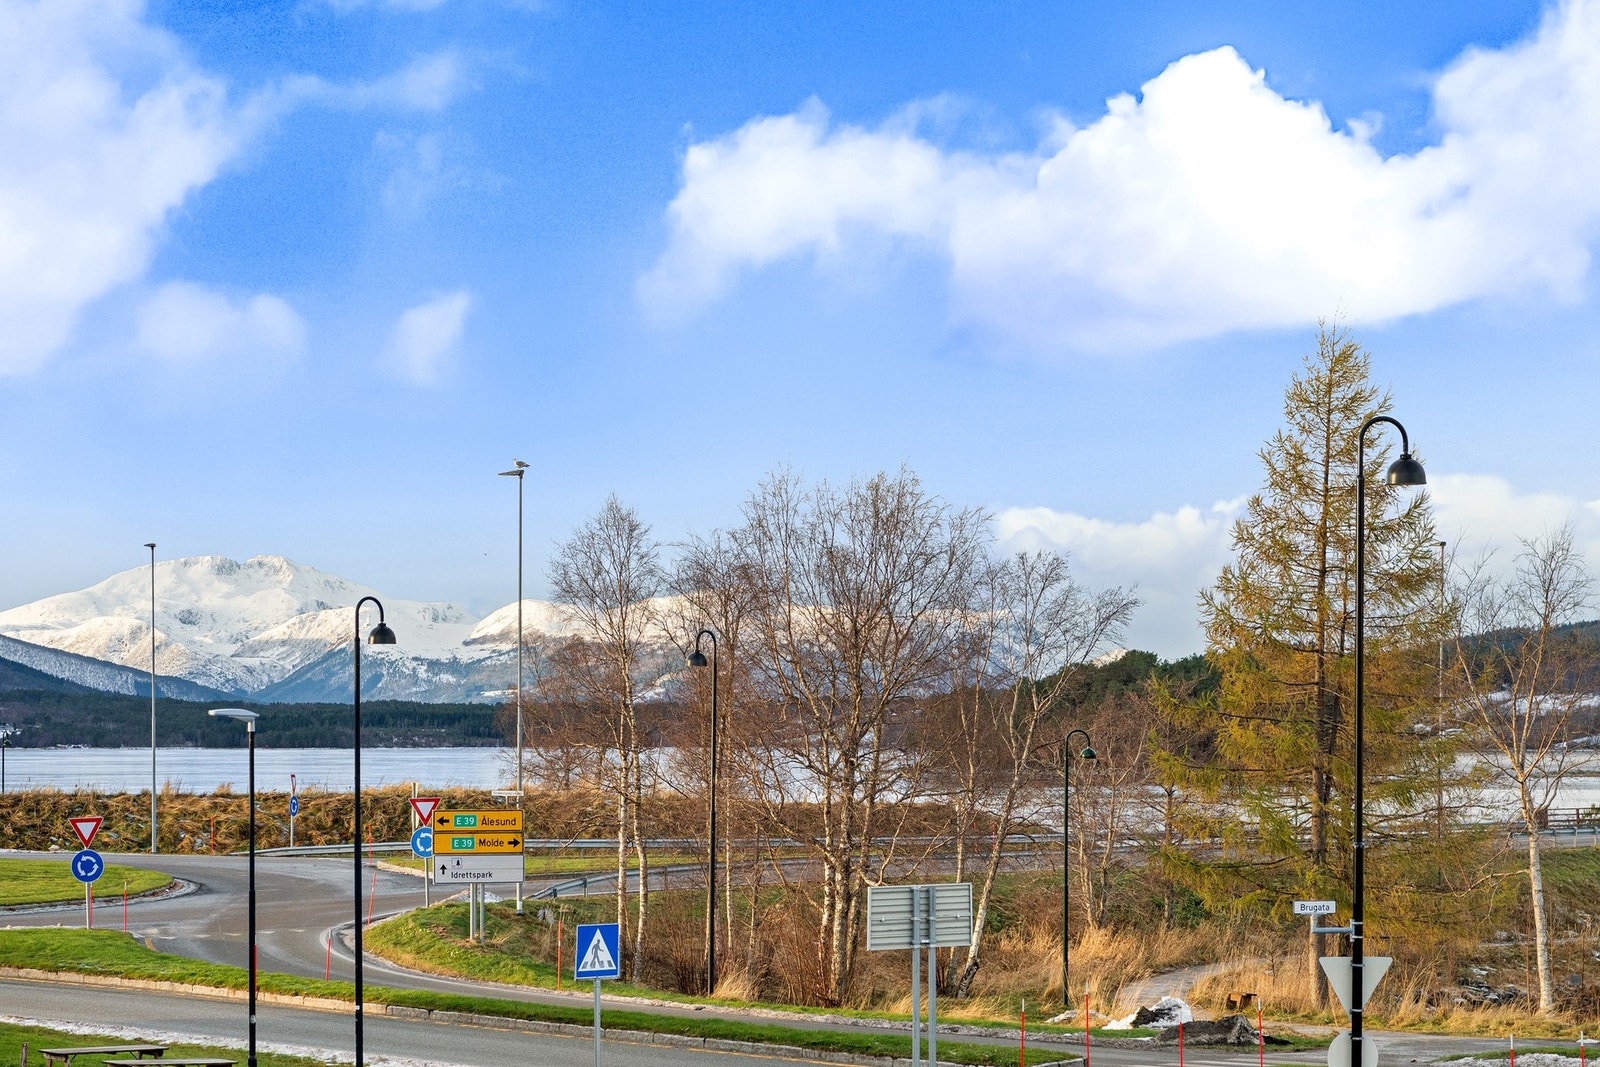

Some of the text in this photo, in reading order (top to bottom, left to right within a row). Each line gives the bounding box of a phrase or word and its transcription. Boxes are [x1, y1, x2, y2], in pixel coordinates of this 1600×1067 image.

[456, 815, 516, 826] E 39 Ålesund
[478, 838, 504, 847] Molde
[451, 871, 493, 879] Idrettspark
[1300, 903, 1330, 913] Brugata
